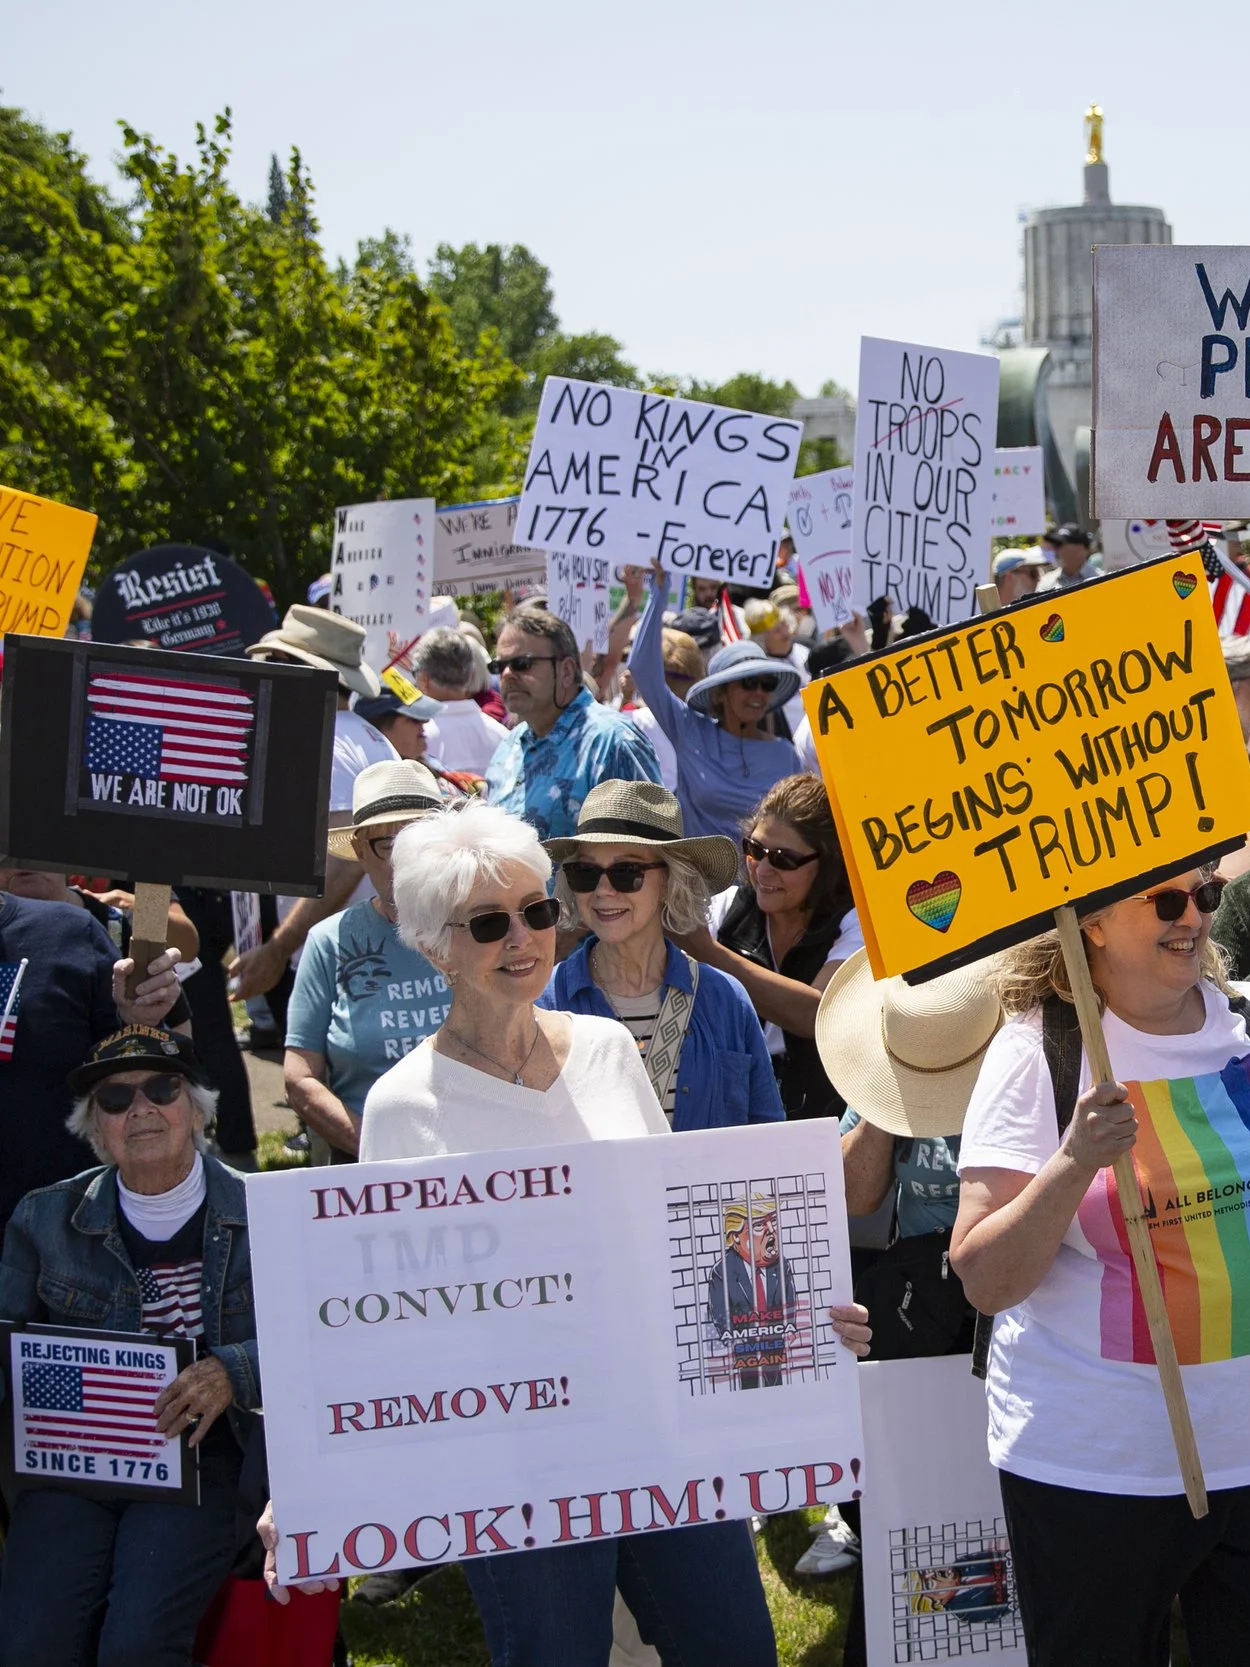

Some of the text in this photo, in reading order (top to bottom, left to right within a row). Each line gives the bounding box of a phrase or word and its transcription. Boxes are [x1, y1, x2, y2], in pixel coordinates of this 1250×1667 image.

[901, 352, 944, 404] NO
[551, 384, 801, 462] NO KINGS
[868, 400, 982, 467] TROOPS
[640, 438, 688, 469] IN
[525, 450, 771, 533] AMERICA
[865, 451, 977, 524] IN OUR
[528, 505, 608, 547] 1776
[0, 542, 75, 595] TION
[113, 554, 223, 611] Resist
[818, 621, 1026, 736] A BETTER
[926, 619, 1195, 765] TOMORROW
[91, 773, 244, 816] WE ARE NOT OK
[861, 688, 1216, 871] BEGINS WITHOUT
[973, 751, 1215, 893] TRUMP!
[310, 1164, 573, 1220] IMPEACH!
[1162, 1216, 1183, 1228] FIRST
[1184, 1210, 1212, 1223] UNITED
[1165, 1195, 1191, 1212] ALL
[318, 1272, 574, 1329] CONVICT!
[732, 1310, 784, 1324] MAKE
[20, 1341, 166, 1370] REJECTING KINGS
[720, 1322, 797, 1341] AMERICA
[735, 1339, 786, 1354] SMILE
[735, 1354, 788, 1369] AGAIN
[327, 1376, 571, 1436] REMOVE!
[25, 1454, 169, 1482] SINCE 1776
[286, 1457, 863, 1580] LOCK! HIM! UP!
[1005, 1550, 1015, 1612] AMERICA
